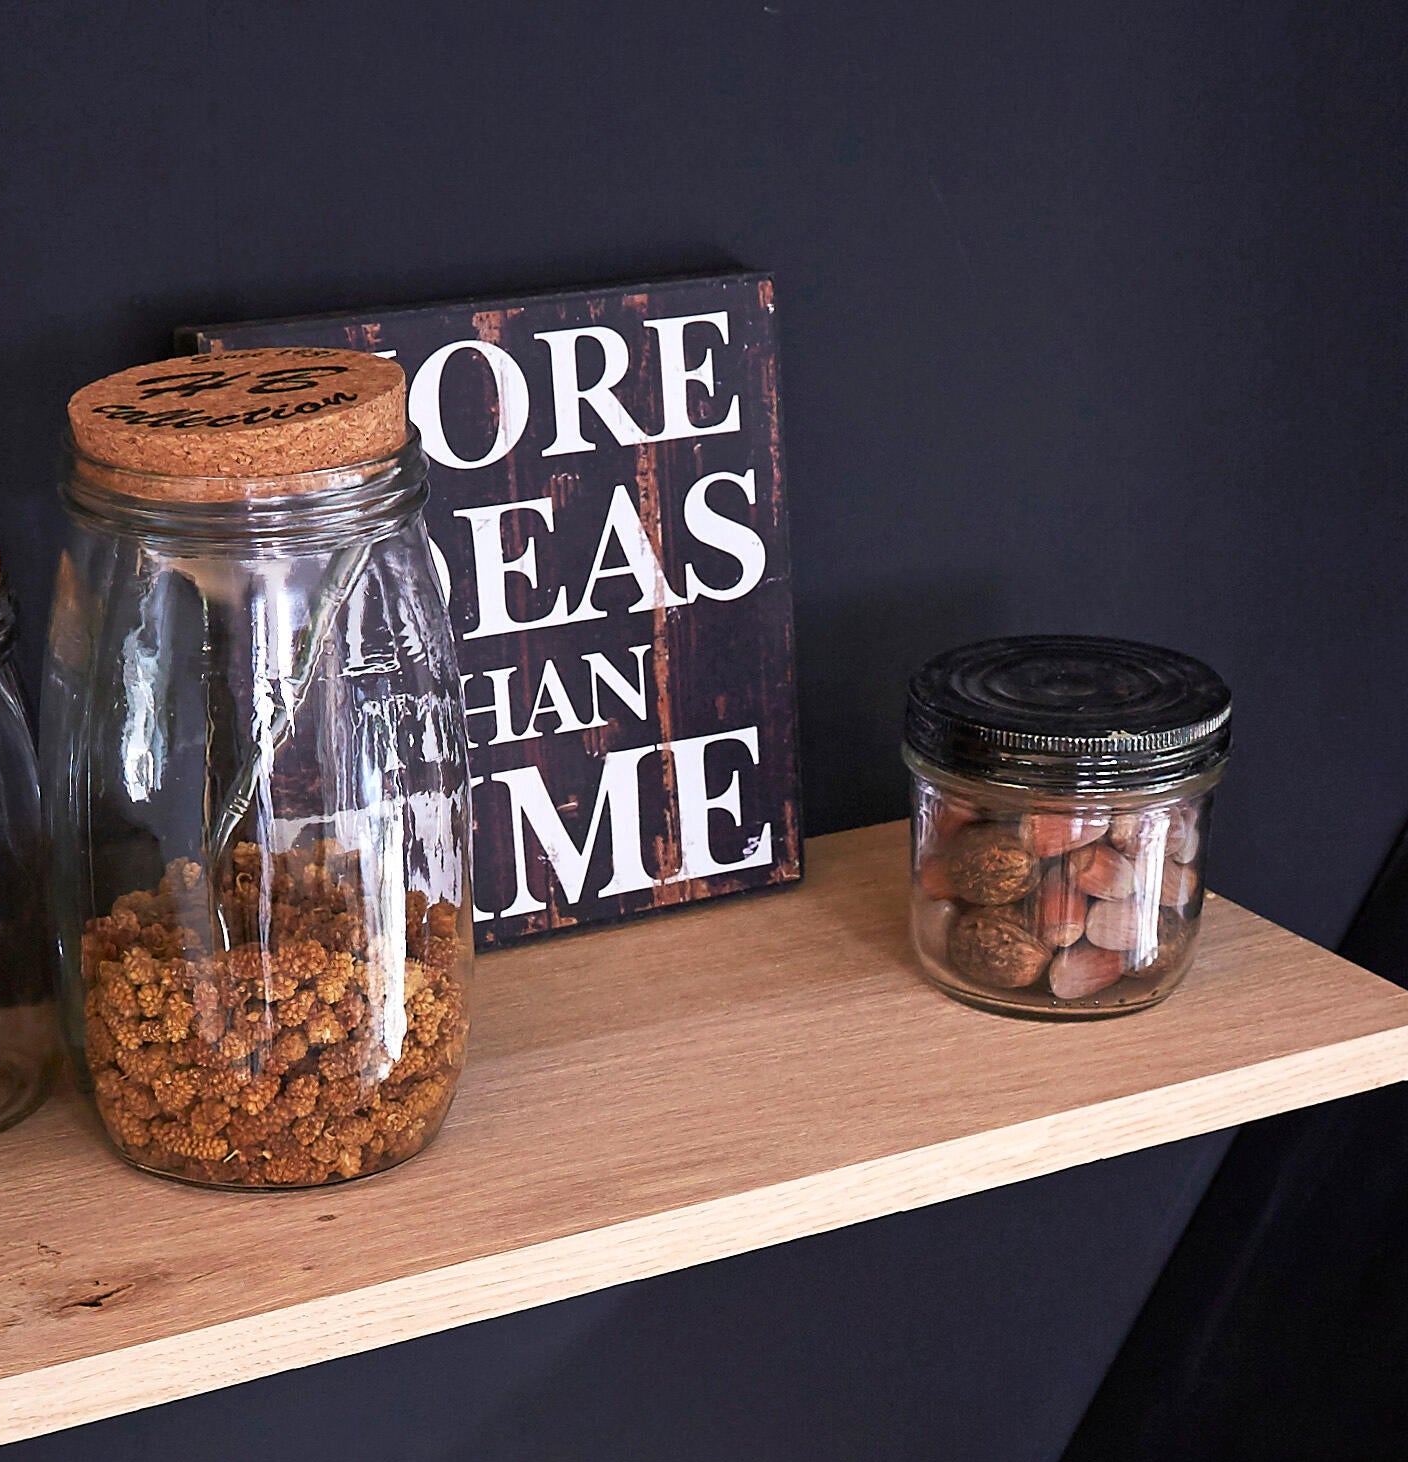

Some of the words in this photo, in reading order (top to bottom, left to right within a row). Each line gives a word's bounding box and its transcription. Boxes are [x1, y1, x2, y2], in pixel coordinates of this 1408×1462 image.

[376, 312, 740, 469] ORE
[426, 468, 767, 641] EAS
[460, 644, 653, 750] HAN
[471, 726, 773, 923] ME
